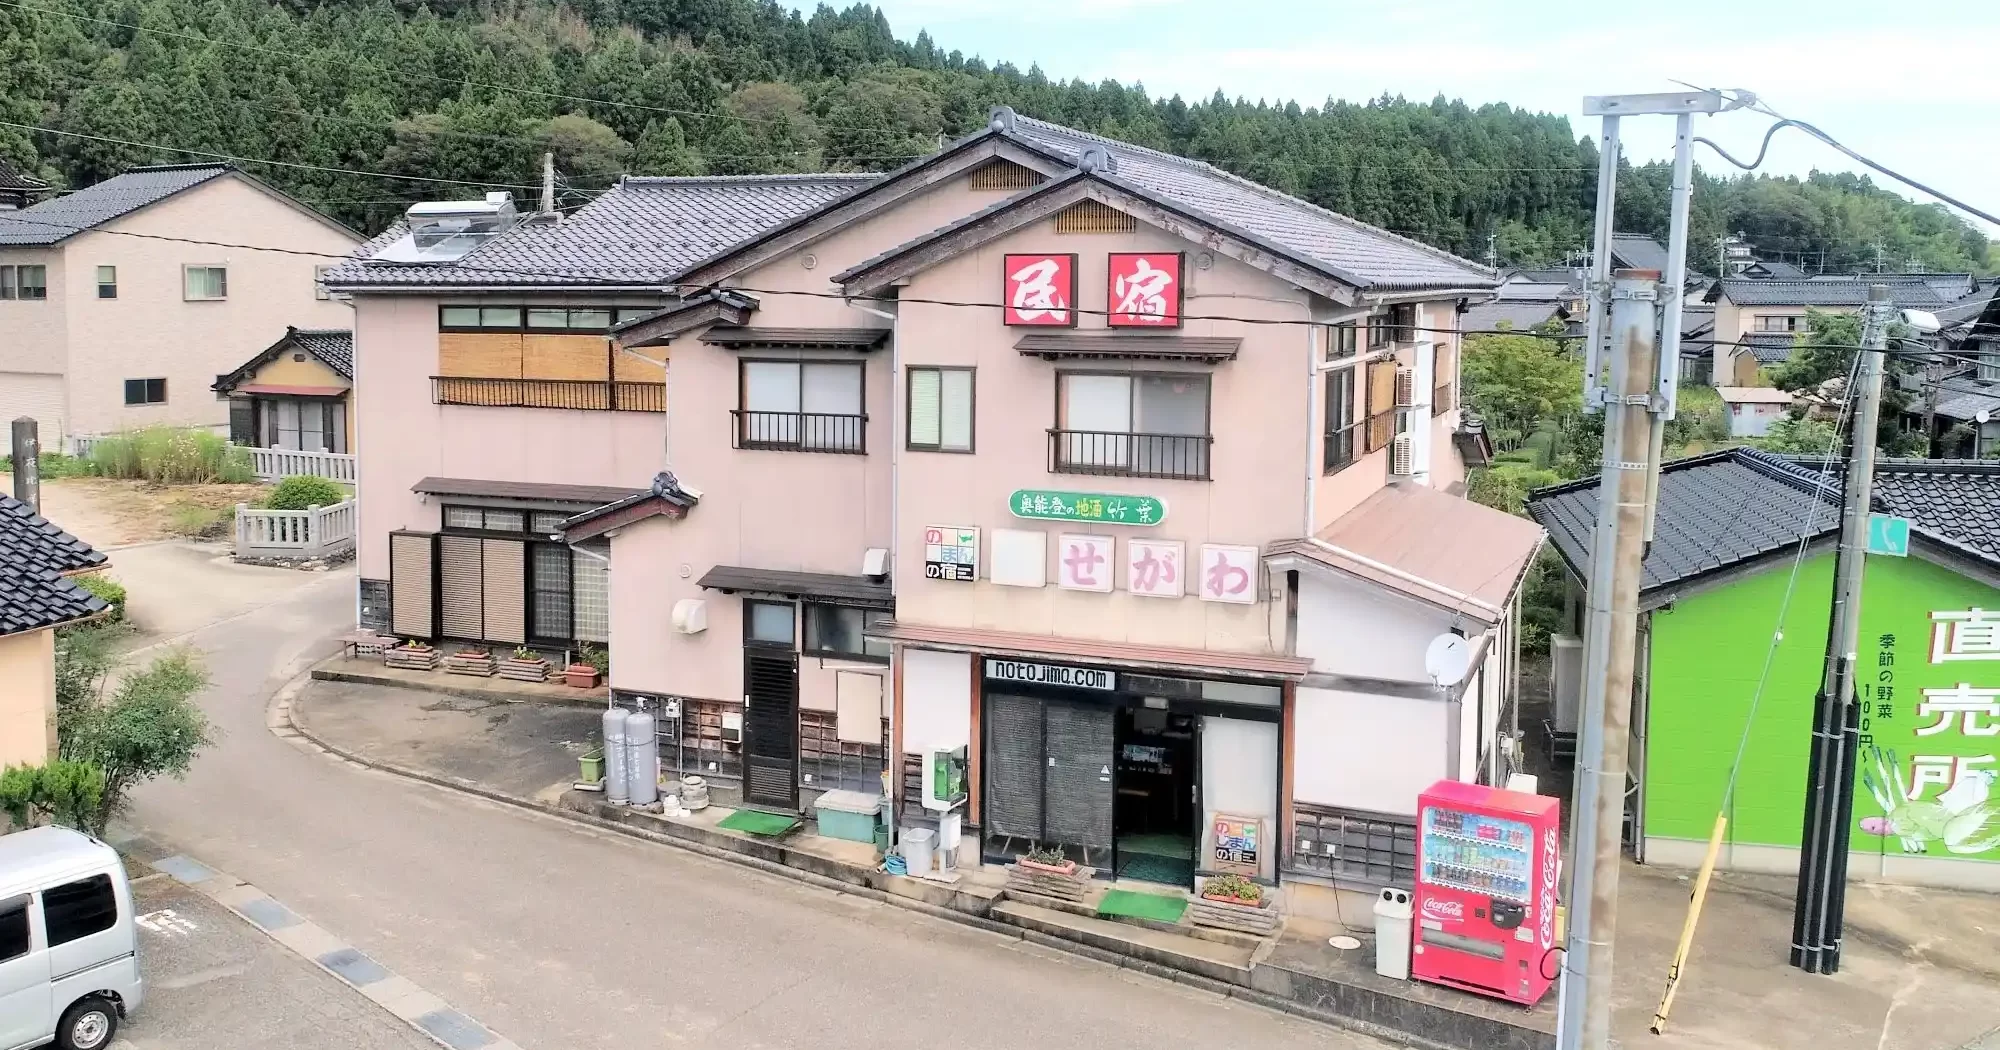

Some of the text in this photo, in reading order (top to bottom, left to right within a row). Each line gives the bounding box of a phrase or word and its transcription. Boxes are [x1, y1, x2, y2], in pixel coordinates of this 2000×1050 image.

[1011, 258, 1173, 322] 民宿
[1064, 542, 1248, 597] せがわ
[995, 661, 1107, 688] notojima.com
[1877, 634, 1896, 718] 季節の野菜
